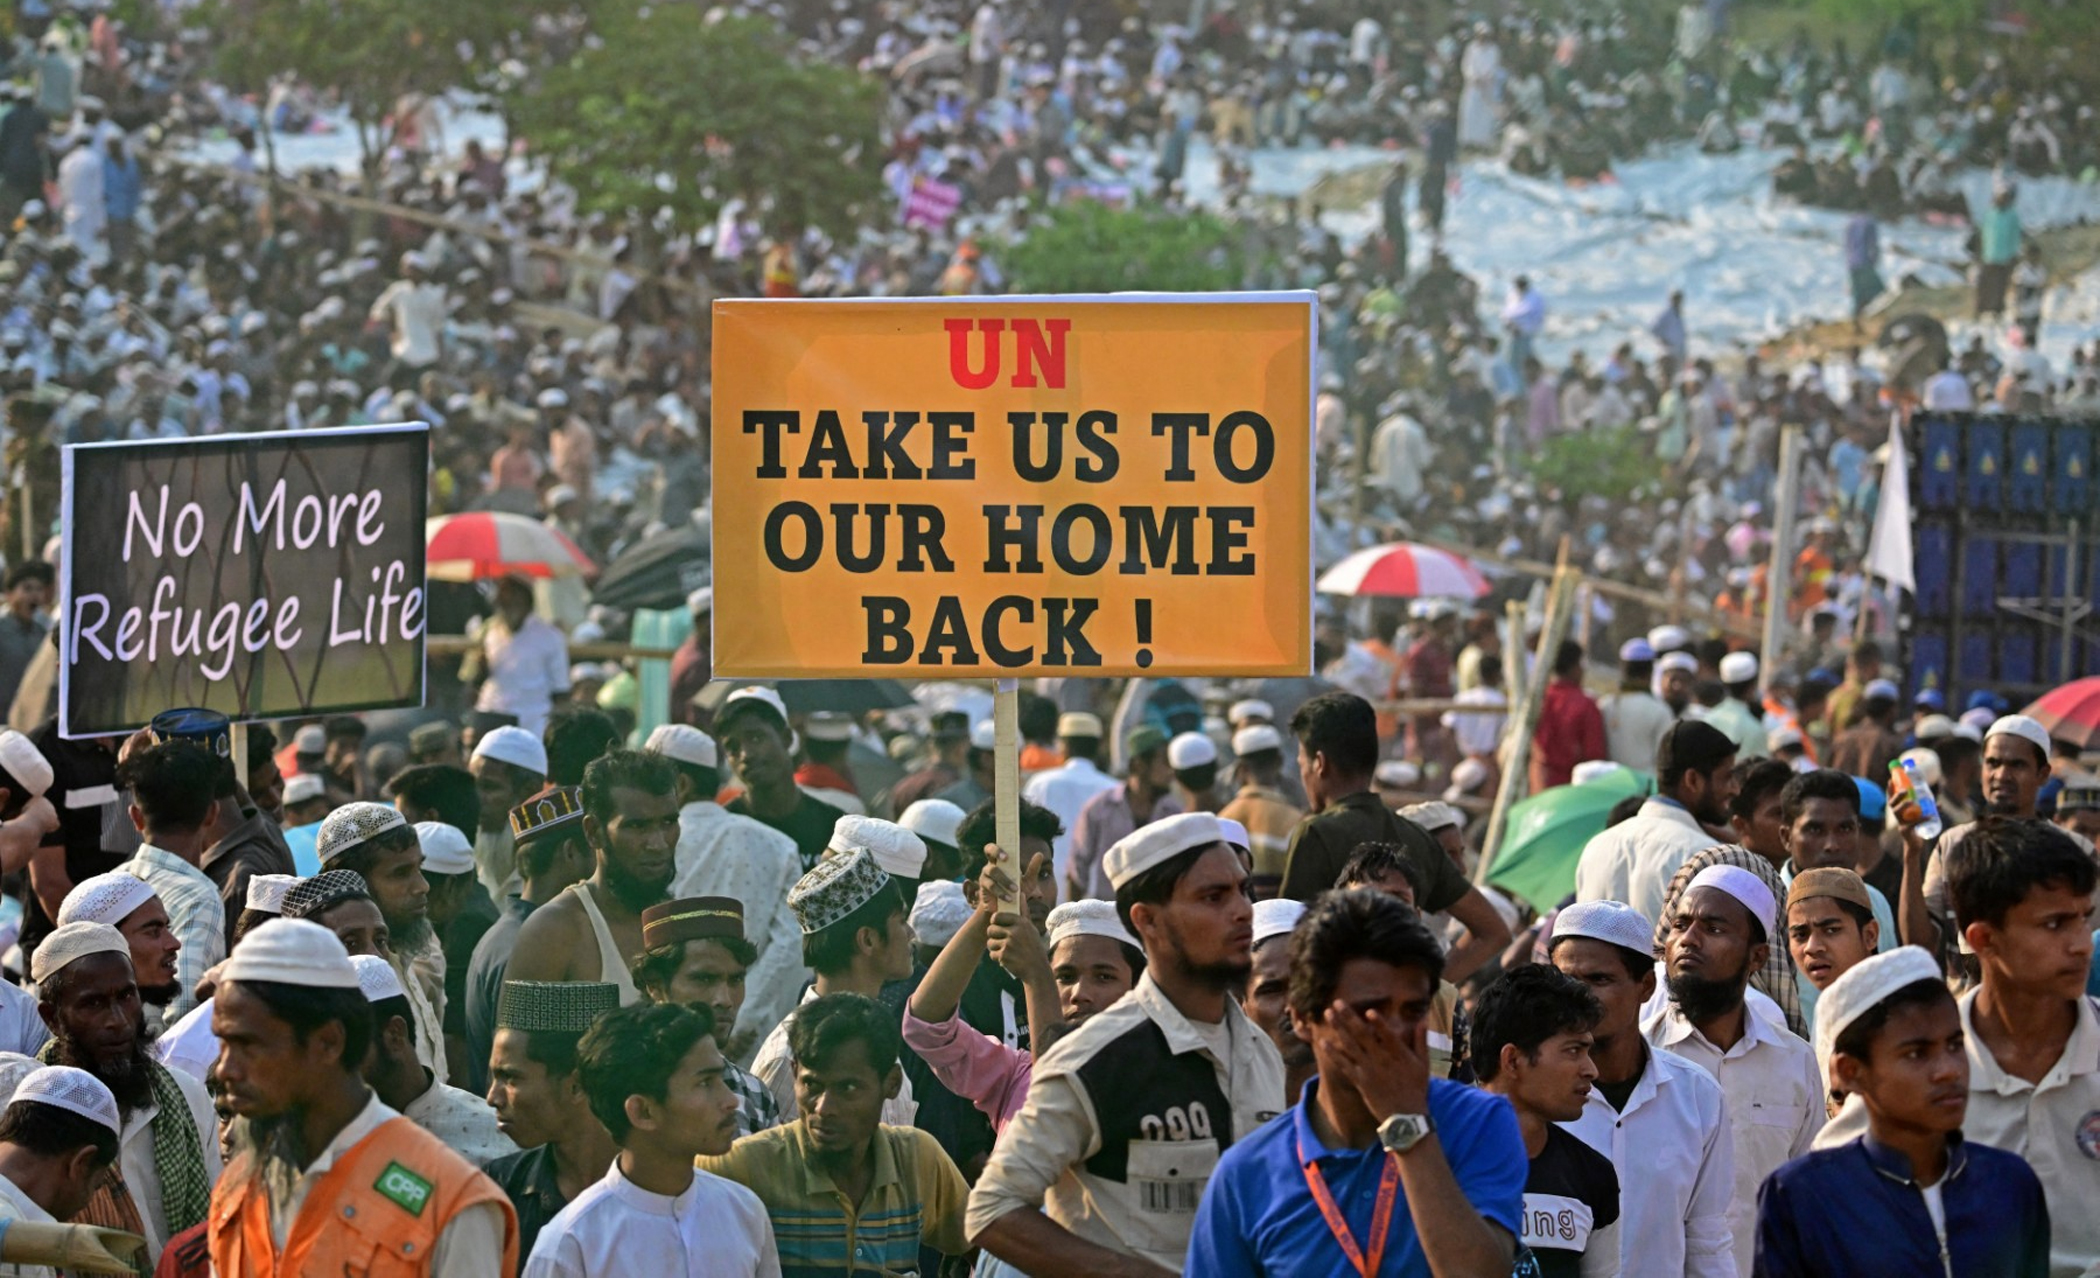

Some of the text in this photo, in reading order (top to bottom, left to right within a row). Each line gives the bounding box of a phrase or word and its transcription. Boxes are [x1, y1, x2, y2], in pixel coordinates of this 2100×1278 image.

[944, 318, 1071, 390] UN
[742, 409, 1275, 484] TAKE US TO
[122, 478, 385, 562] No More
[764, 500, 1256, 576] OUR HOME
[70, 559, 425, 681] Refugee Life
[861, 594, 1103, 668] BACK
[386, 1172, 426, 1202] CPP
